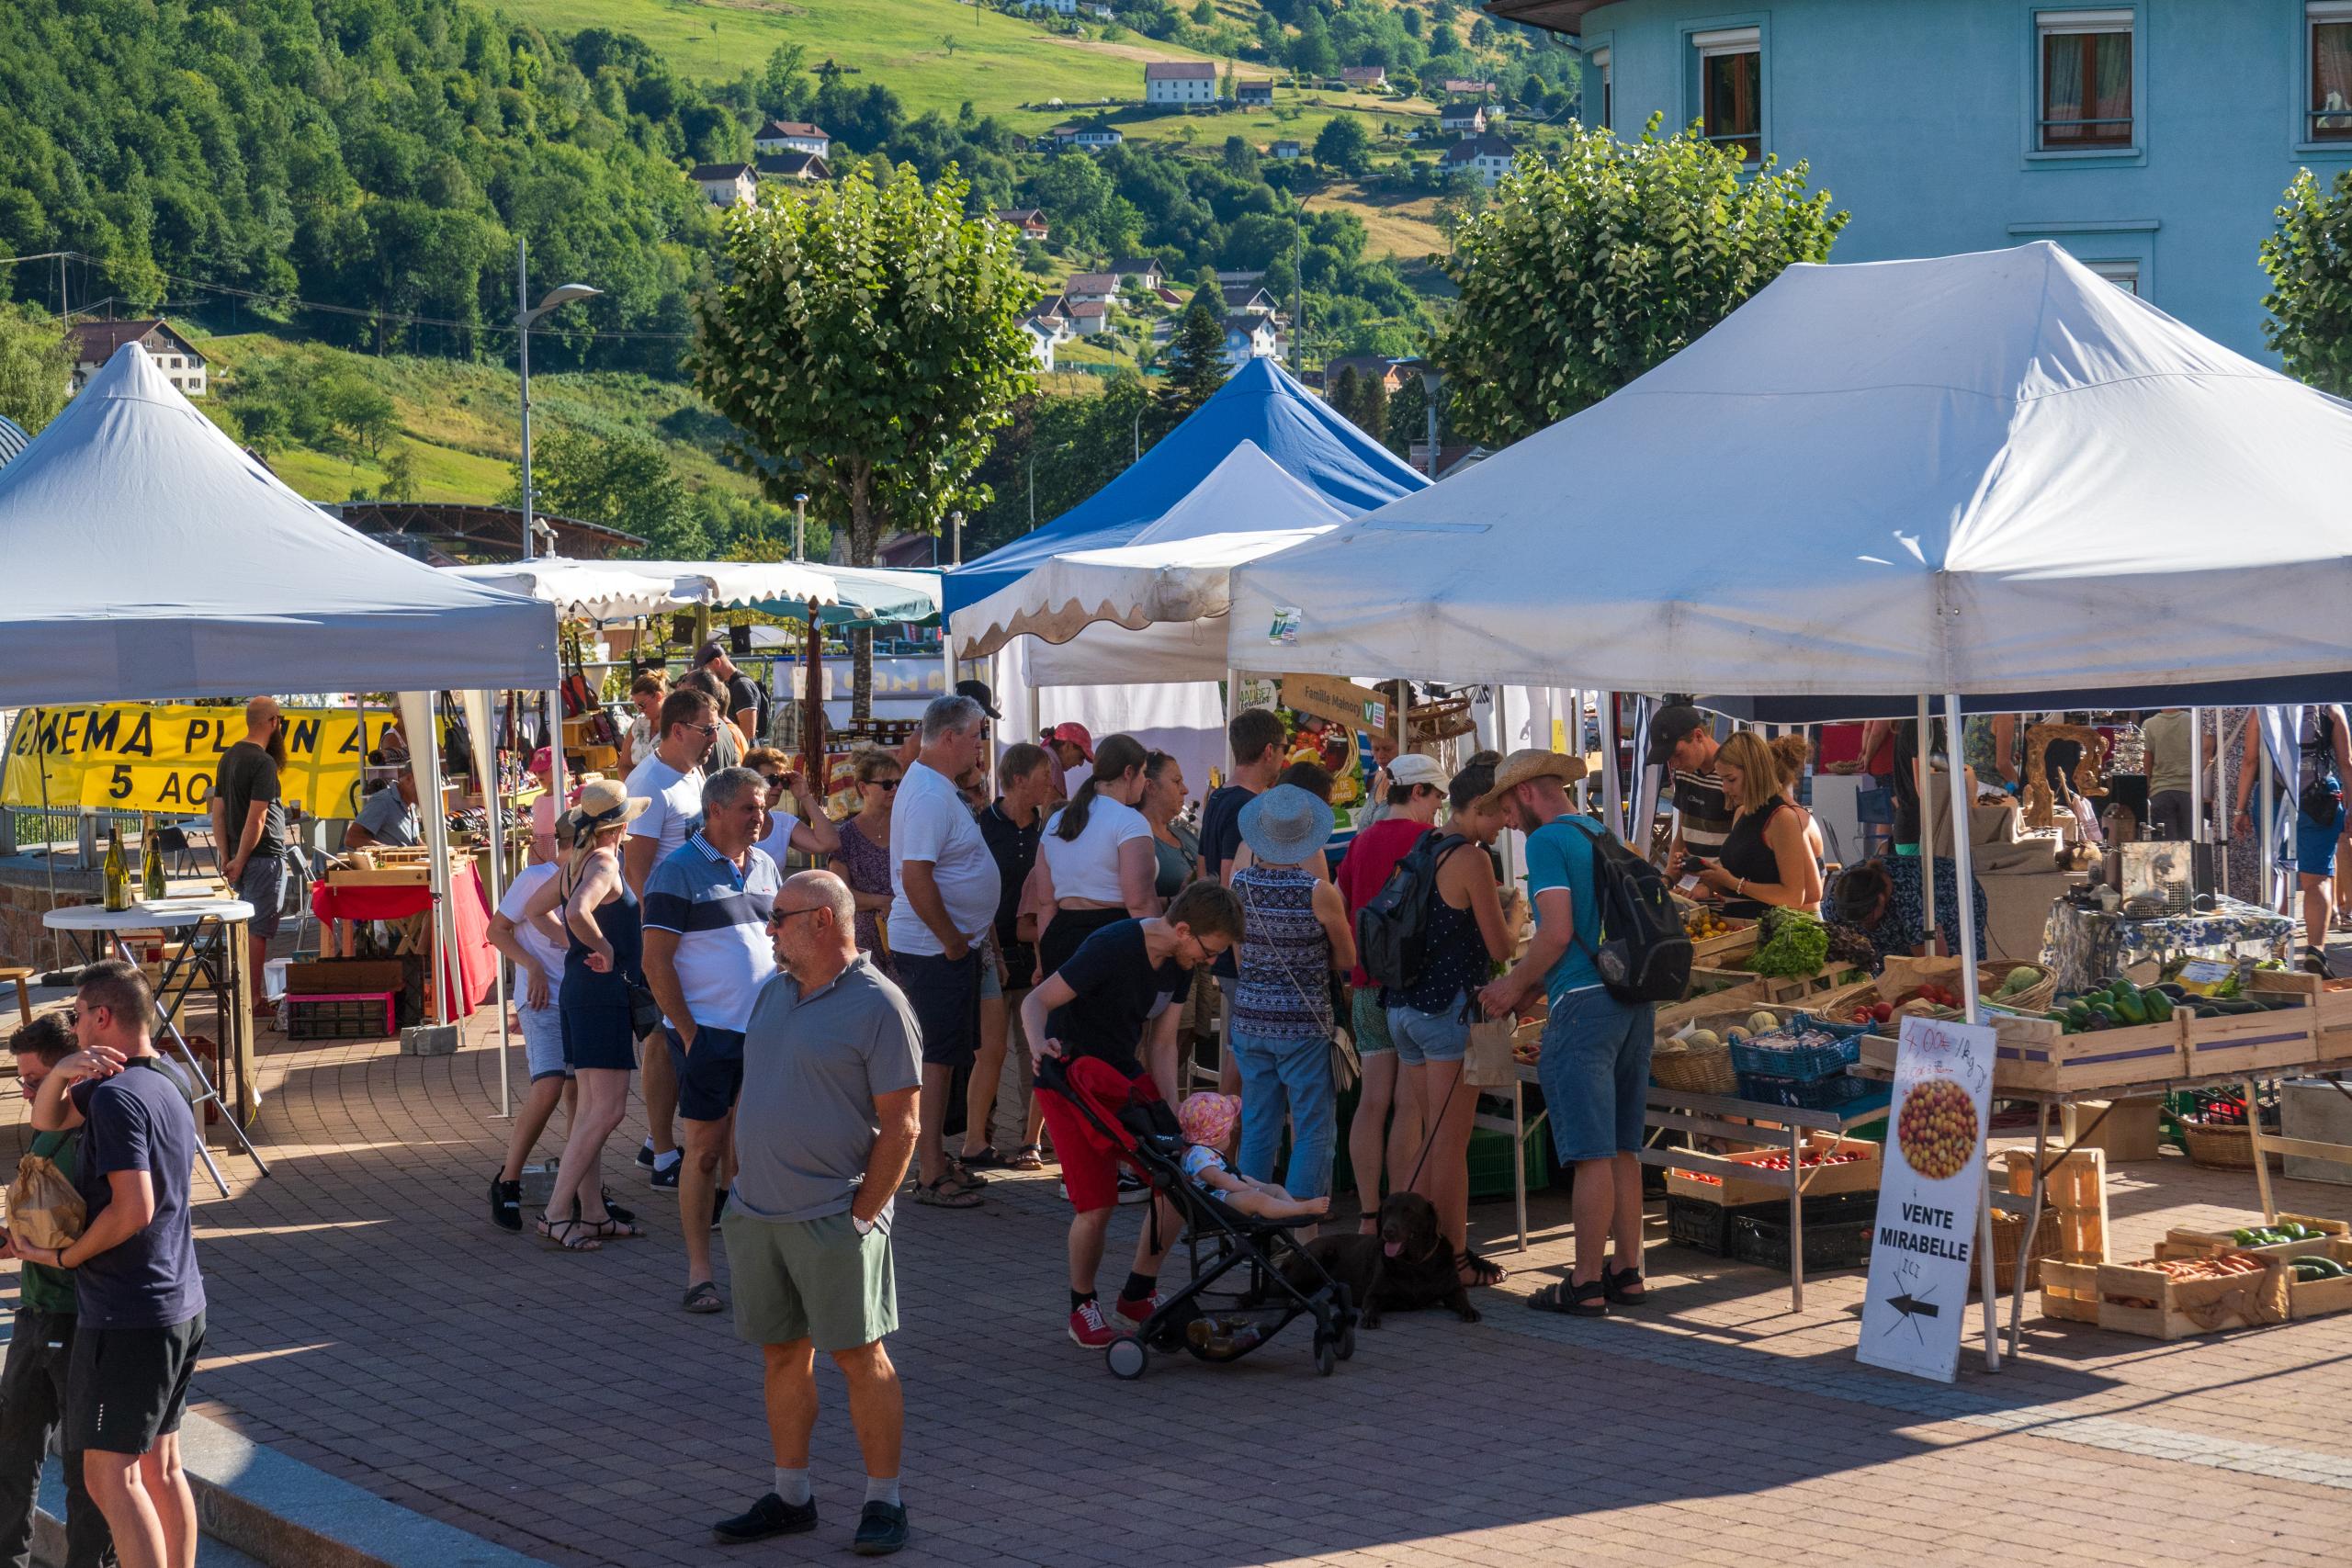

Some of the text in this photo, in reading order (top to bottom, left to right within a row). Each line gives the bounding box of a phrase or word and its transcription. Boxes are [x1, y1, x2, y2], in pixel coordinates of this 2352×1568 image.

[1305, 685, 1330, 705] Famille
[185, 716, 321, 753] PLIN
[109, 764, 133, 798] 5
[1902, 1201, 1953, 1230] VENTE
[1880, 1227, 1969, 1262] MIRABELLE
[1902, 1258, 1921, 1279] ICI
